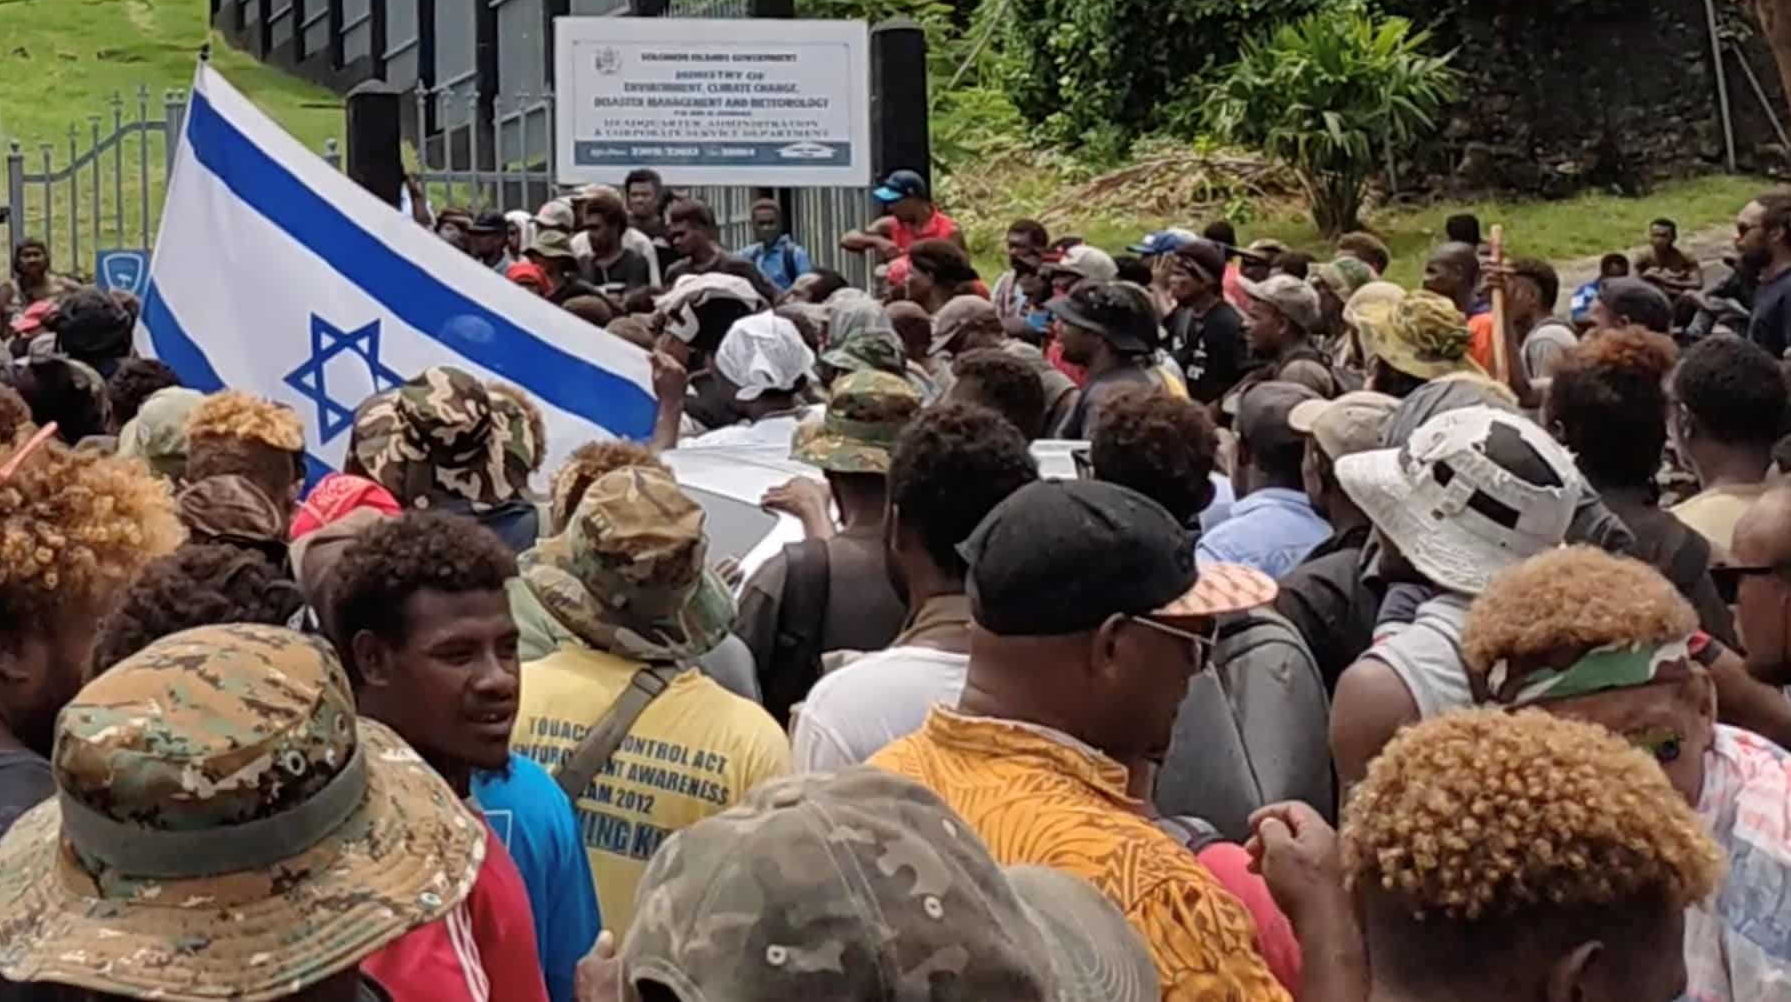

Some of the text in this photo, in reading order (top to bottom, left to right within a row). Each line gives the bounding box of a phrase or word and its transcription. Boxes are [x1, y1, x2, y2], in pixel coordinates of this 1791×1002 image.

[732, 53, 797, 62] GOVERNMENT
[675, 70, 764, 80] MINISTRY OF
[706, 83, 751, 93] CLIMATE
[593, 97, 829, 107] DISASTER MANAGEMENT AND METEOROLOGY
[620, 735, 689, 767] ONTROL
[692, 749, 727, 774] ACT
[627, 762, 729, 806] AWARENESS
[616, 787, 655, 814] 2012
